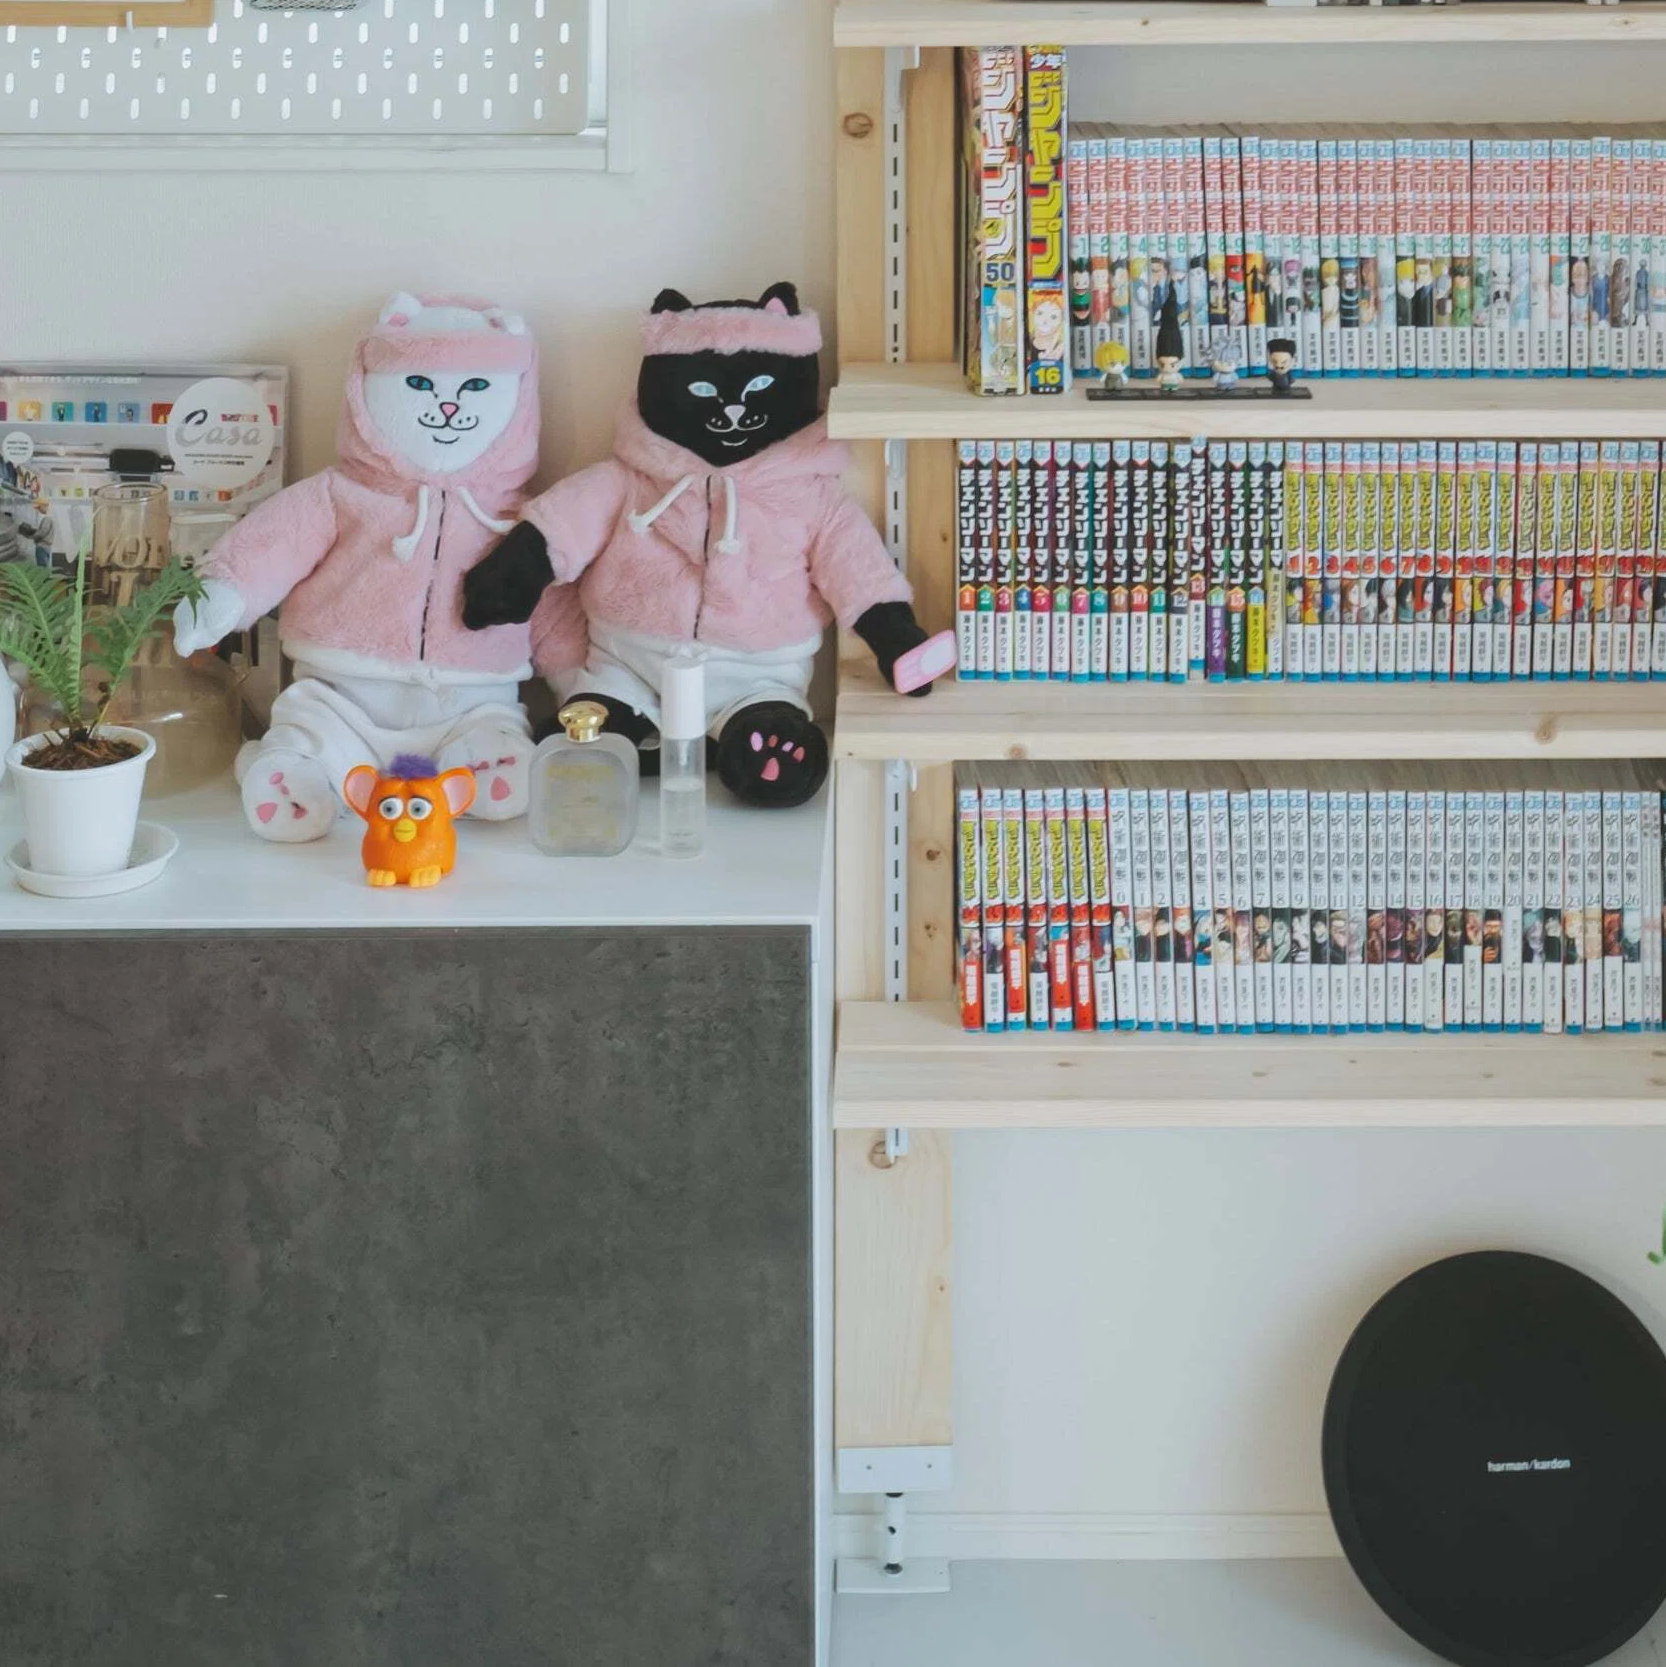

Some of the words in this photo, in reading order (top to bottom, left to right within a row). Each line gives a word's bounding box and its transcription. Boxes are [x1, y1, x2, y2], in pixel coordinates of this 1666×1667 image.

[1029, 71, 1064, 278] ジャンプ
[985, 262, 1016, 282] 50
[1035, 367, 1061, 384] 16
[175, 408, 264, 448] Casa
[1269, 471, 1283, 569] チェンソーマ
[964, 591, 971, 604] 1
[980, 591, 990, 605] 2
[998, 592, 1010, 606] 3
[1017, 591, 1028, 605] 4
[1076, 594, 1087, 607] 7
[1094, 593, 1104, 606] 8
[1116, 892, 1126, 904] 0
[1156, 892, 1166, 905] 2
[1196, 895, 1206, 908] 4
[1217, 893, 1227, 905] 5
[1256, 892, 1265, 905] 7
[1352, 894, 1365, 907] 12
[1390, 894, 1403, 906] 14
[1507, 894, 1521, 906] 20
[1586, 893, 1601, 906] 24
[1606, 894, 1620, 906] 25
[1487, 1458, 1571, 1472] harman/kardon
